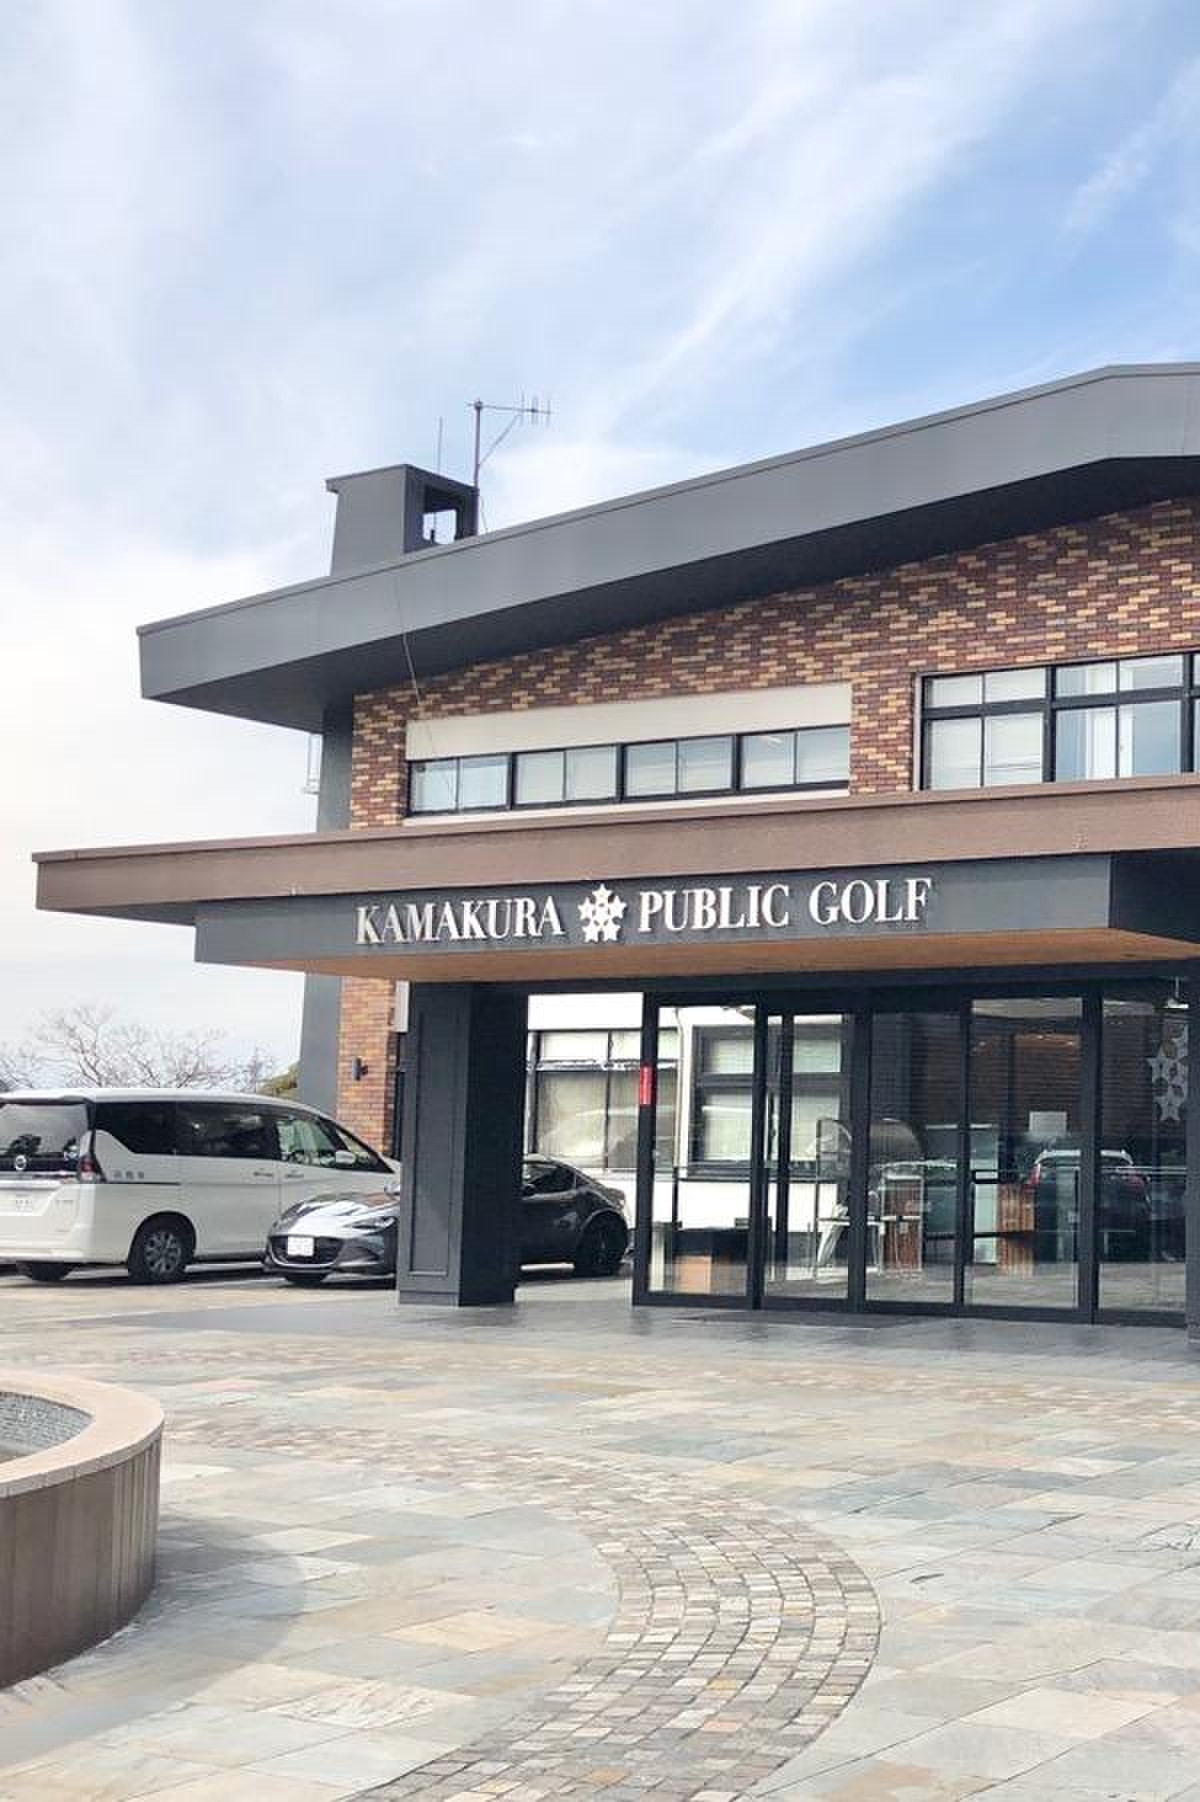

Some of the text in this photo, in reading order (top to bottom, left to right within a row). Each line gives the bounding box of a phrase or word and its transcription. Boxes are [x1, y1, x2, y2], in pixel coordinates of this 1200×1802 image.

[355, 877, 932, 944] KAMAKURA PUBLIC GOLF
